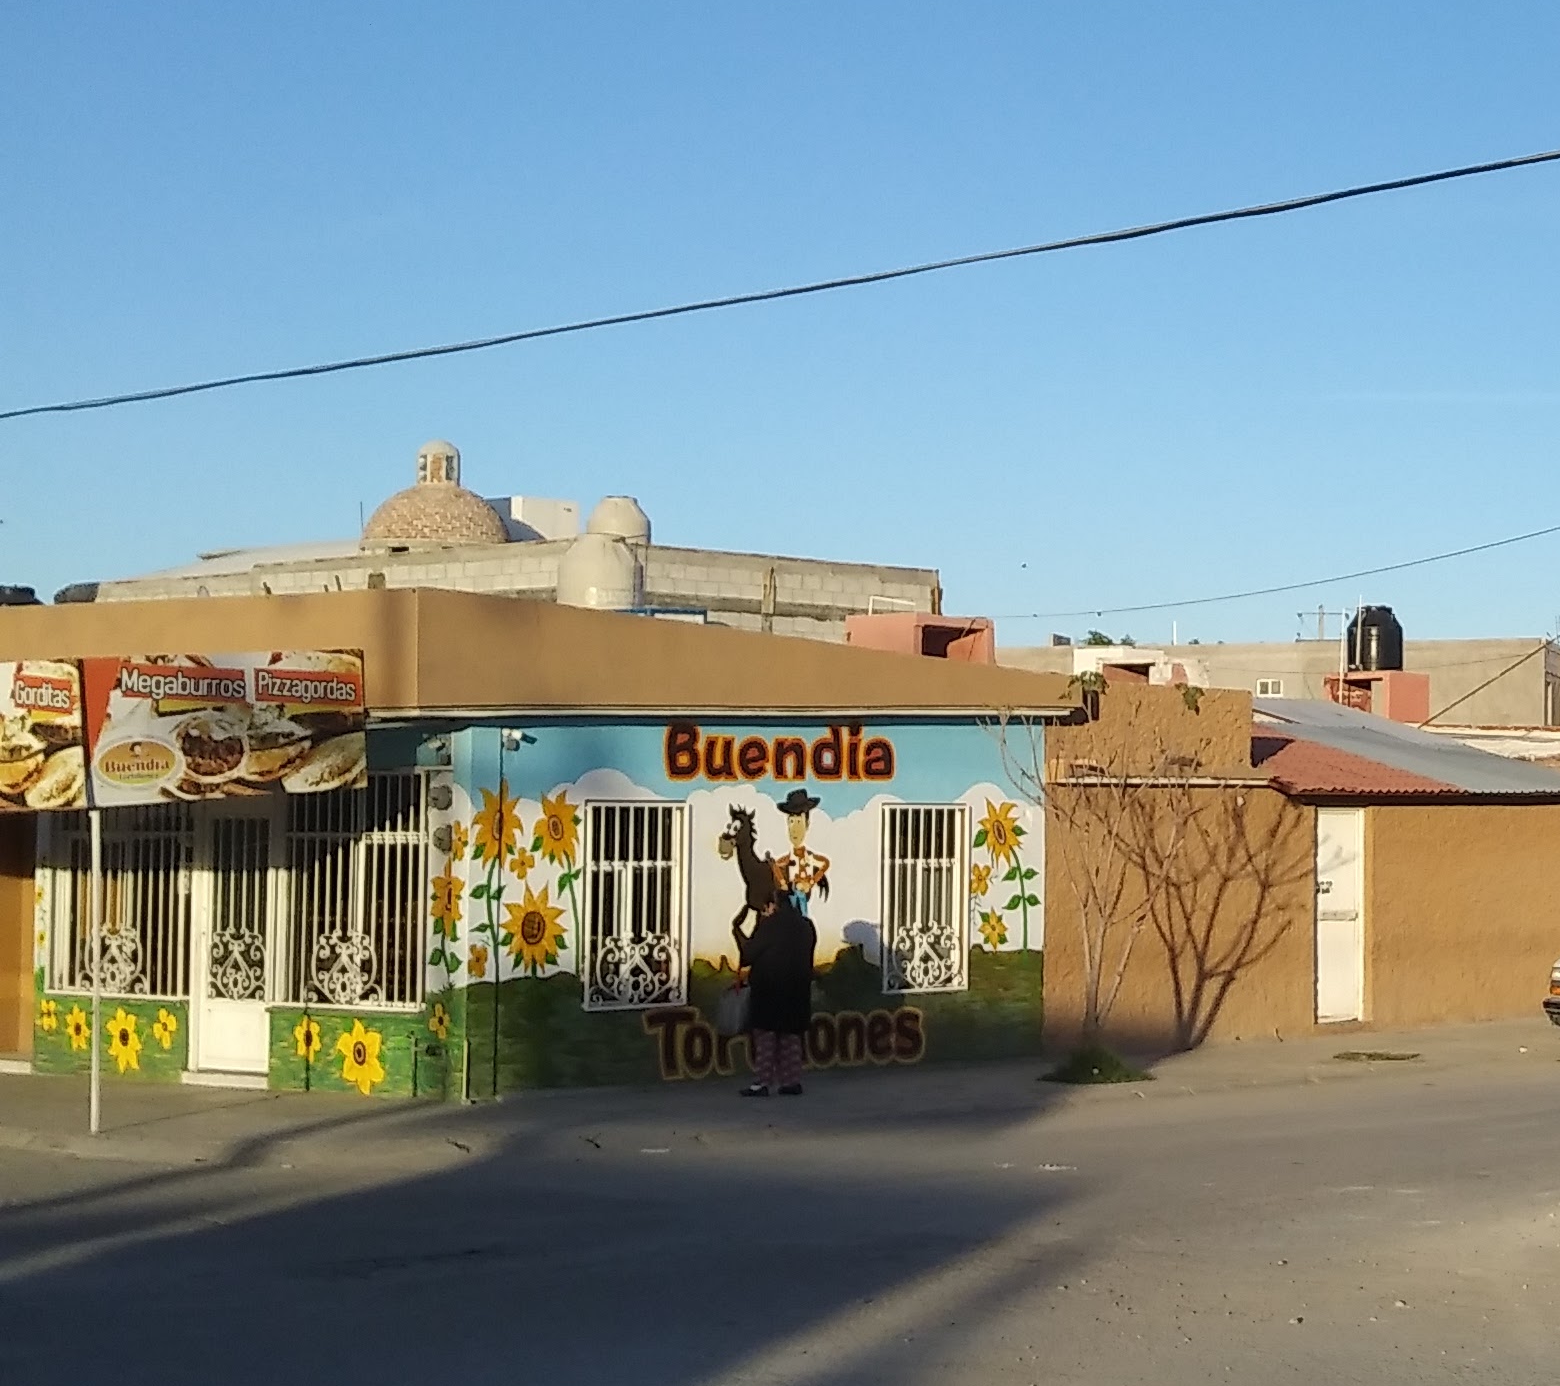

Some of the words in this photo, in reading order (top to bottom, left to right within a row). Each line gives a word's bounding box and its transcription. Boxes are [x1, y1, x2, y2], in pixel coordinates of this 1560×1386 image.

[15, 680, 70, 707] Gorditas
[120, 667, 246, 699] Megaburros
[258, 671, 356, 704] Pizzagordas
